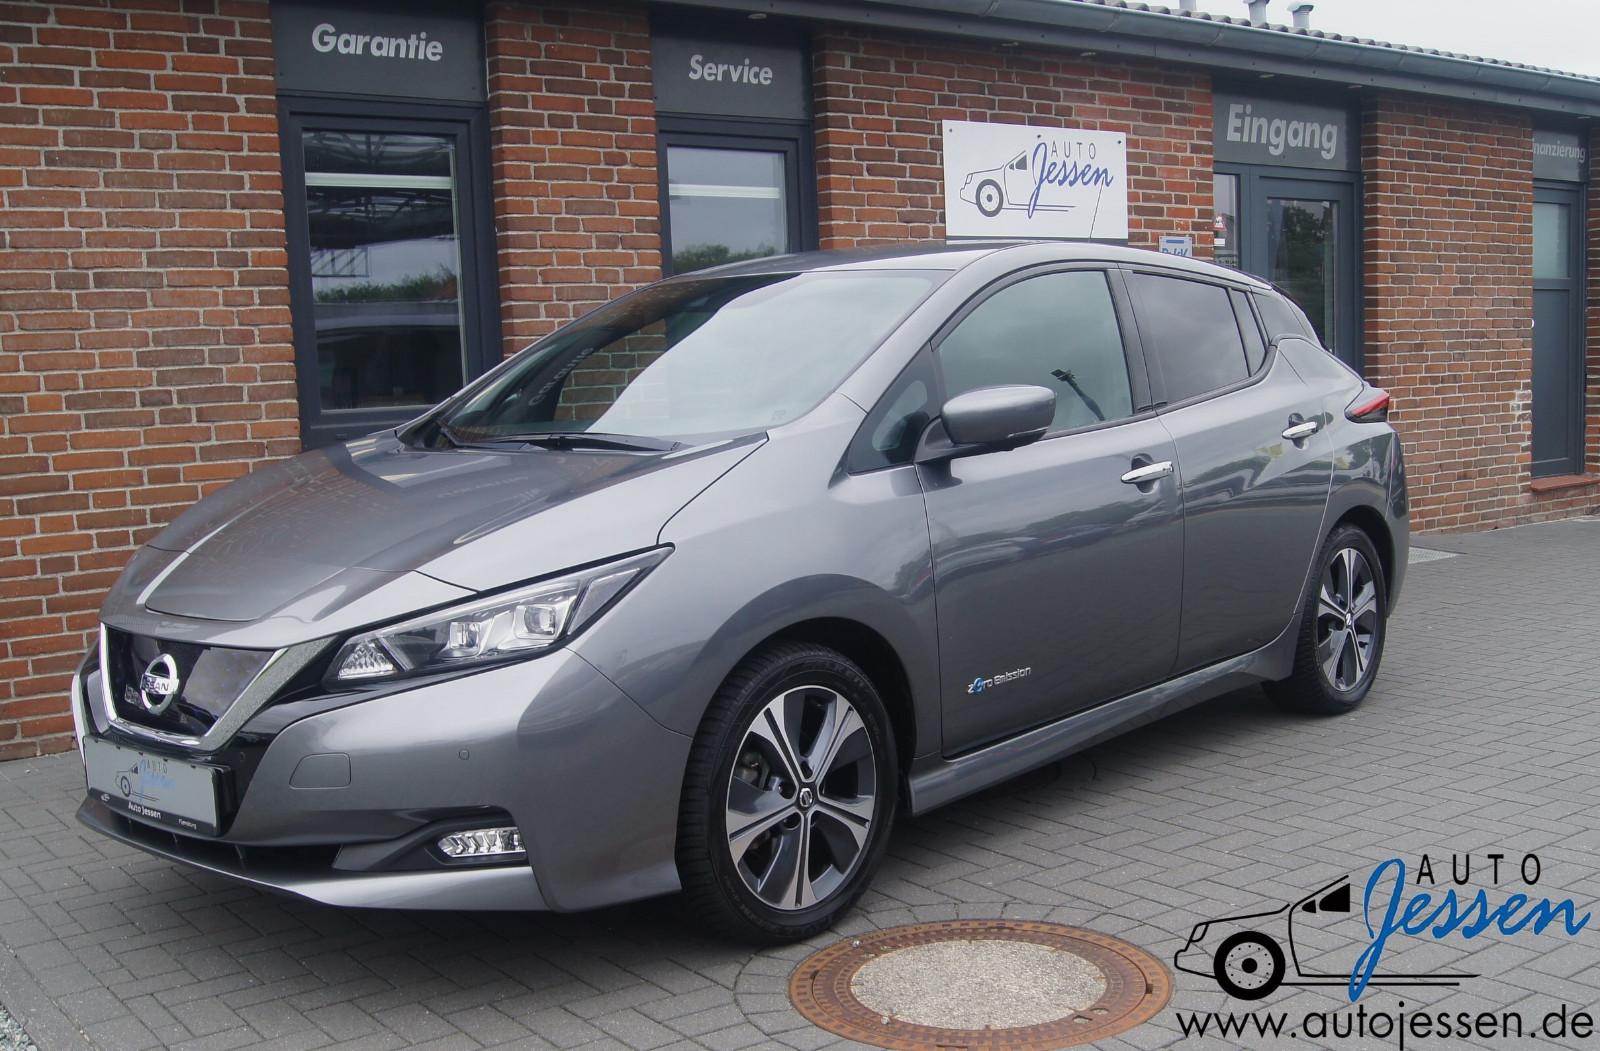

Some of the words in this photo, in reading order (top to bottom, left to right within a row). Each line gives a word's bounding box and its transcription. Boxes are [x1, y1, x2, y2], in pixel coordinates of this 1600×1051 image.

[311, 23, 443, 61] Garantie
[689, 54, 773, 85] Service
[1226, 104, 1338, 160] Eingang
[1051, 140, 1096, 160] AUTO
[1531, 138, 1585, 164] nanzierung
[1028, 142, 1113, 219] Jessen
[993, 667, 1031, 685] Emission
[128, 802, 142, 813] Auto
[142, 806, 161, 819] Jessen
